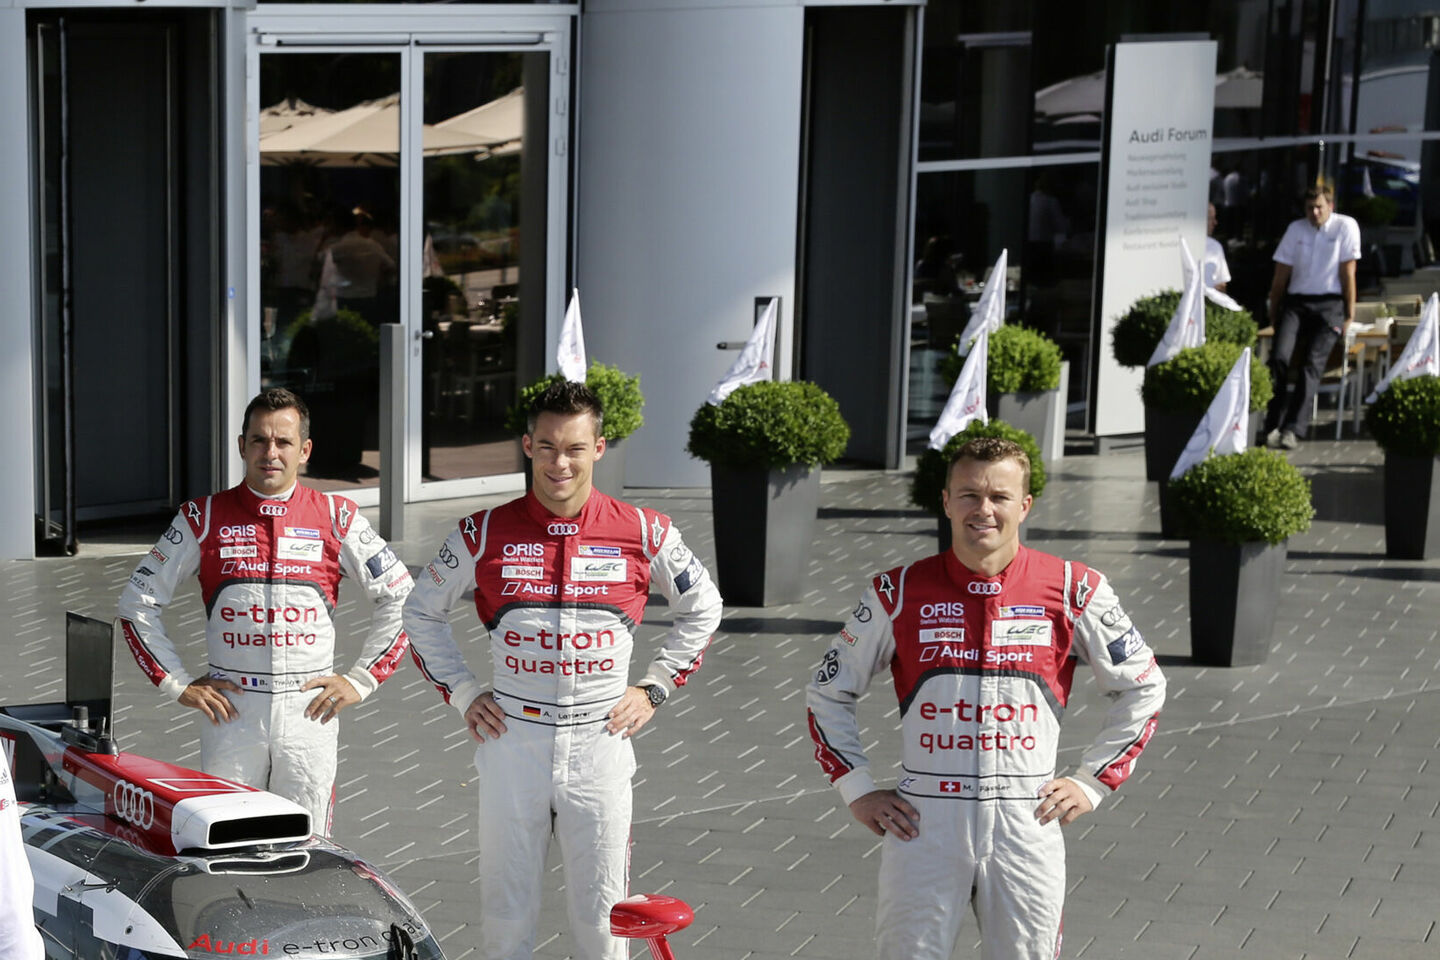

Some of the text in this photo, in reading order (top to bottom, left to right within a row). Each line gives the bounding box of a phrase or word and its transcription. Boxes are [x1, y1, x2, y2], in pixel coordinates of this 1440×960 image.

[1128, 127, 1207, 144] Audi Forum
[219, 524, 257, 538] ORIS
[502, 543, 545, 556] ORIS
[238, 561, 312, 576] Audi Sport
[515, 568, 542, 577] BOSCH
[522, 582, 609, 597] Audi Sport
[220, 604, 318, 624] e-tron
[920, 602, 965, 618] ORIS
[222, 631, 317, 649] quattro
[504, 629, 615, 651] e-tron
[934, 631, 962, 639] BOSCH
[940, 645, 1033, 665] Audi Sport
[504, 655, 615, 676] quattro
[920, 698, 1038, 722] e-tron
[920, 733, 1036, 754] quattro
[187, 933, 269, 955] Audi
[282, 935, 377, 955] e-tron
